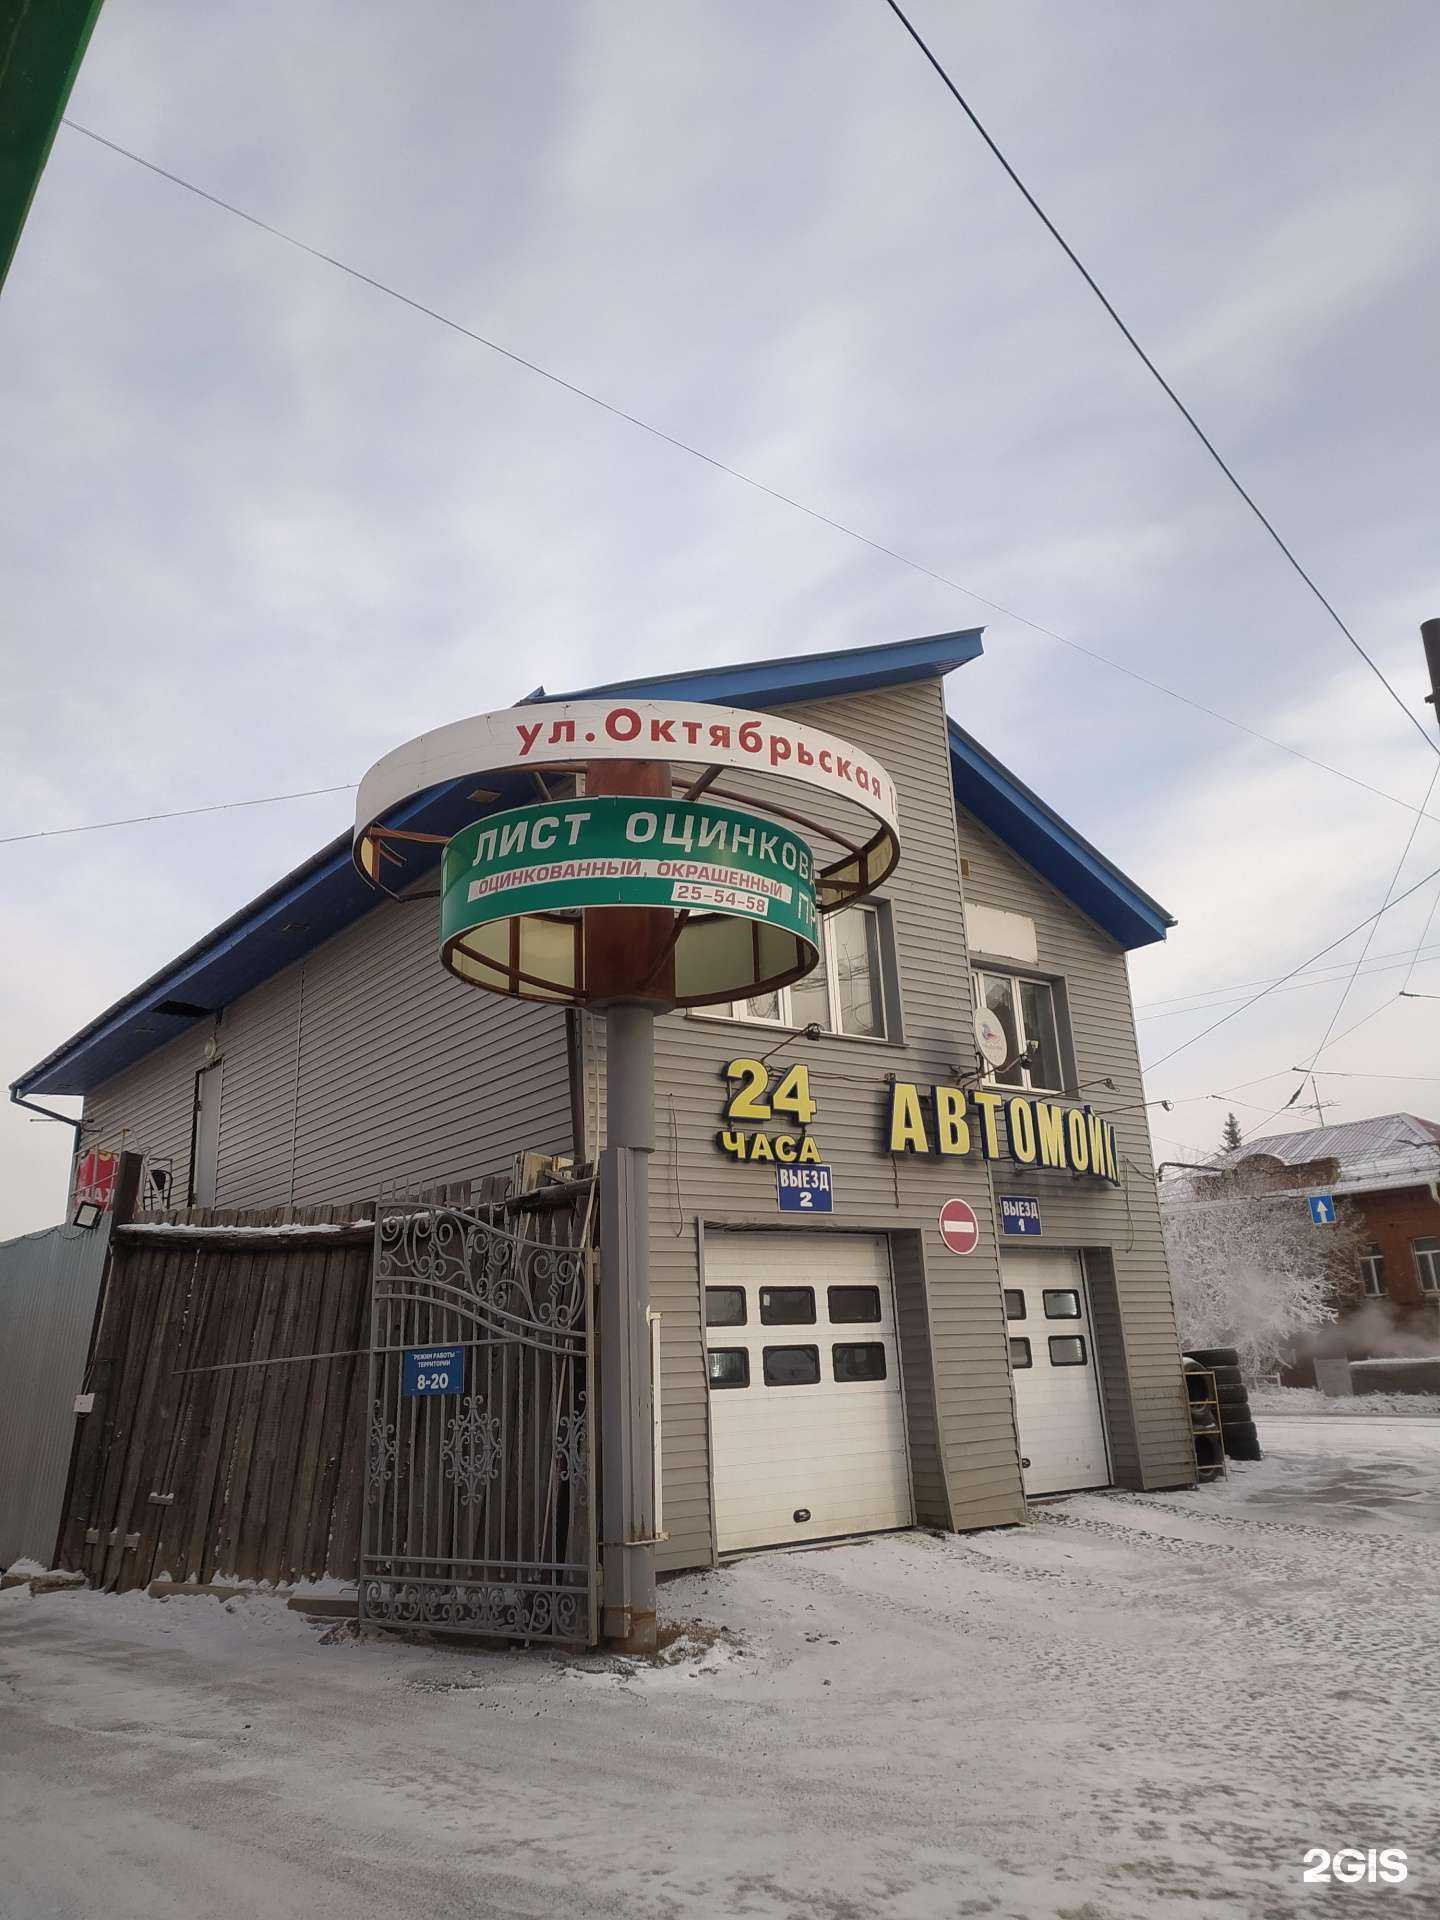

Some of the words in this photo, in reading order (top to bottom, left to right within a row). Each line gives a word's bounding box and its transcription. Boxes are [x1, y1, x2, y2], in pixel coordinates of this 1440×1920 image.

[472, 812, 592, 867] ЛИСТ
[677, 885, 766, 913] 25-54-58
[724, 1058, 817, 1124] 24
[885, 1082, 1121, 1186] АВТОМОЙК
[717, 1130, 824, 1164] ЧАСА
[780, 1168, 829, 1191] ВЫЕЗД
[800, 1191, 813, 1207] 2
[1002, 1201, 1039, 1219] ВЫЕЗД
[1018, 1218, 1026, 1232] 1
[417, 1373, 449, 1390] 8-20
